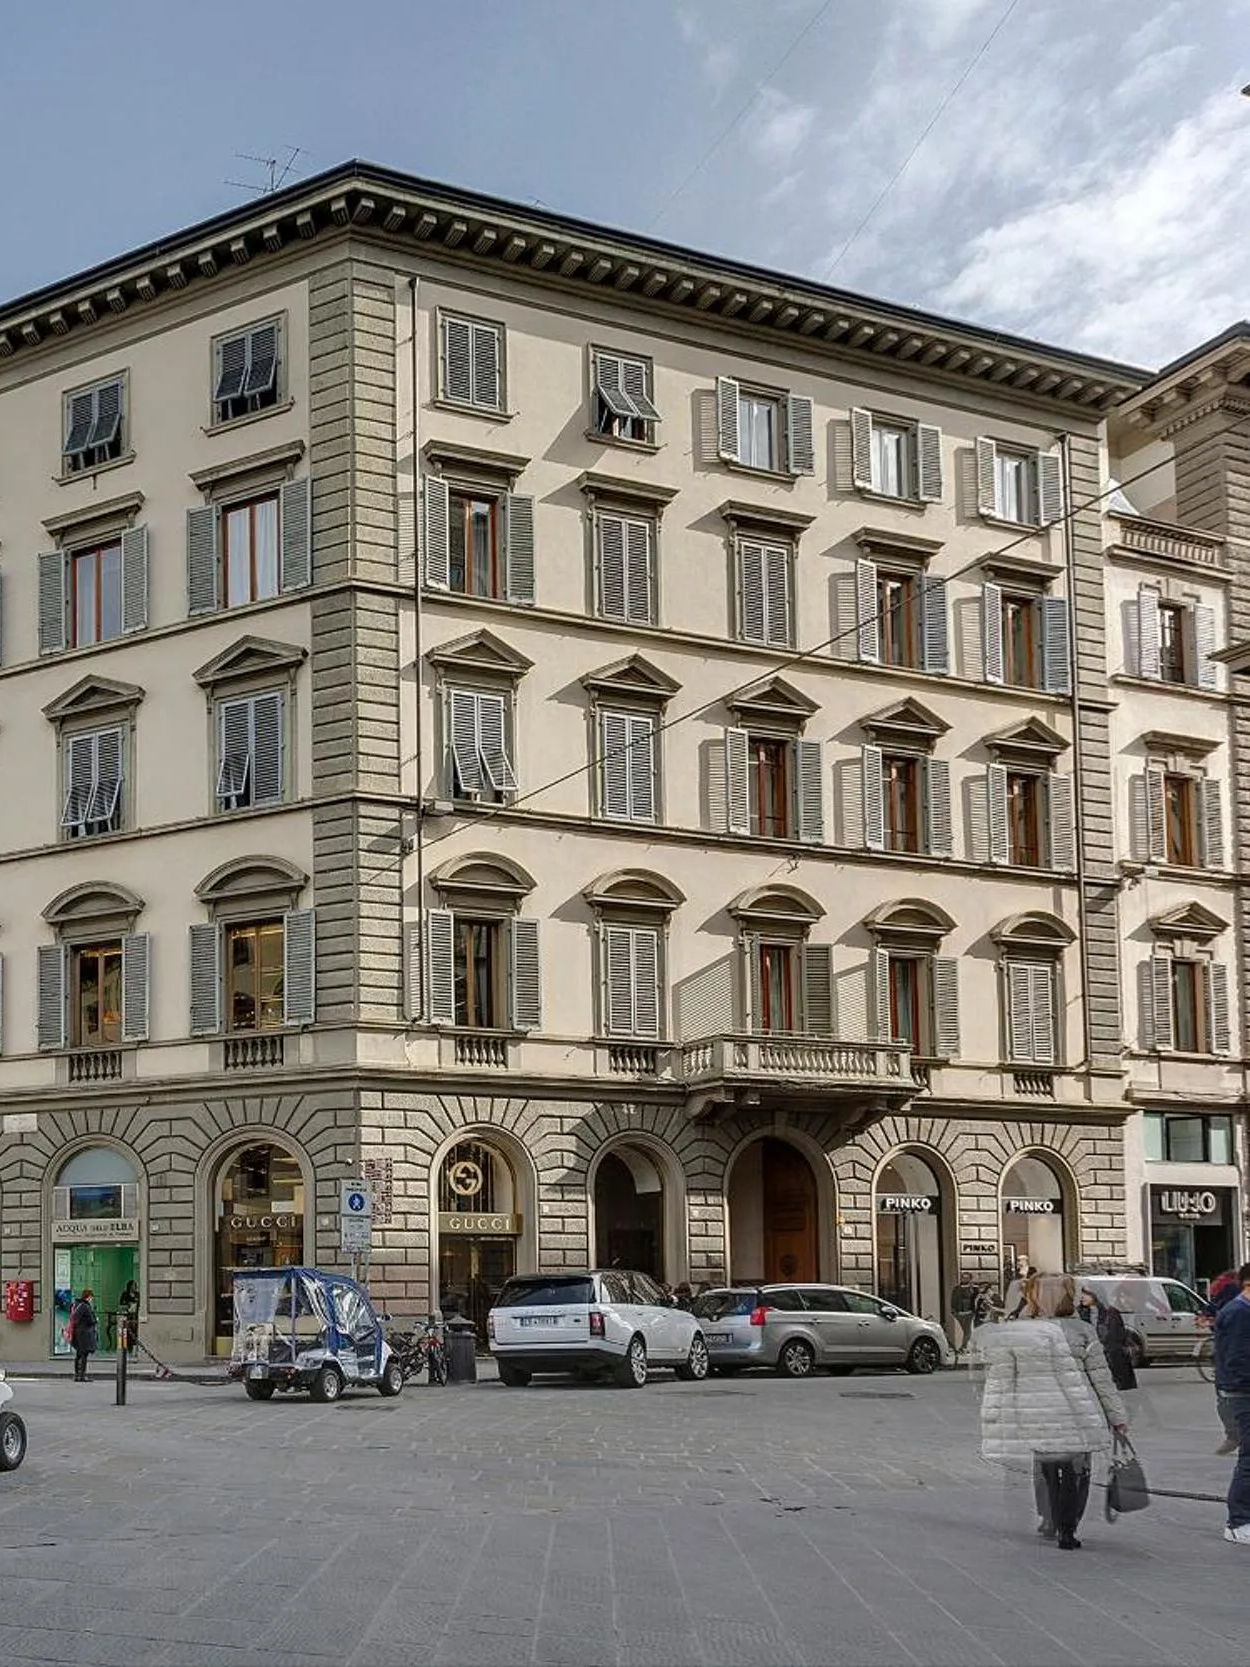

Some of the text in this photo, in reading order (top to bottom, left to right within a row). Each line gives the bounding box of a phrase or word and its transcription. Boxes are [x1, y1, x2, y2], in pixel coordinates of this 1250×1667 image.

[885, 1197, 932, 1210] PINKO
[1009, 1199, 1055, 1212] PINKO
[231, 1216, 296, 1229] GUCCI
[450, 1217, 510, 1230] GUCCI
